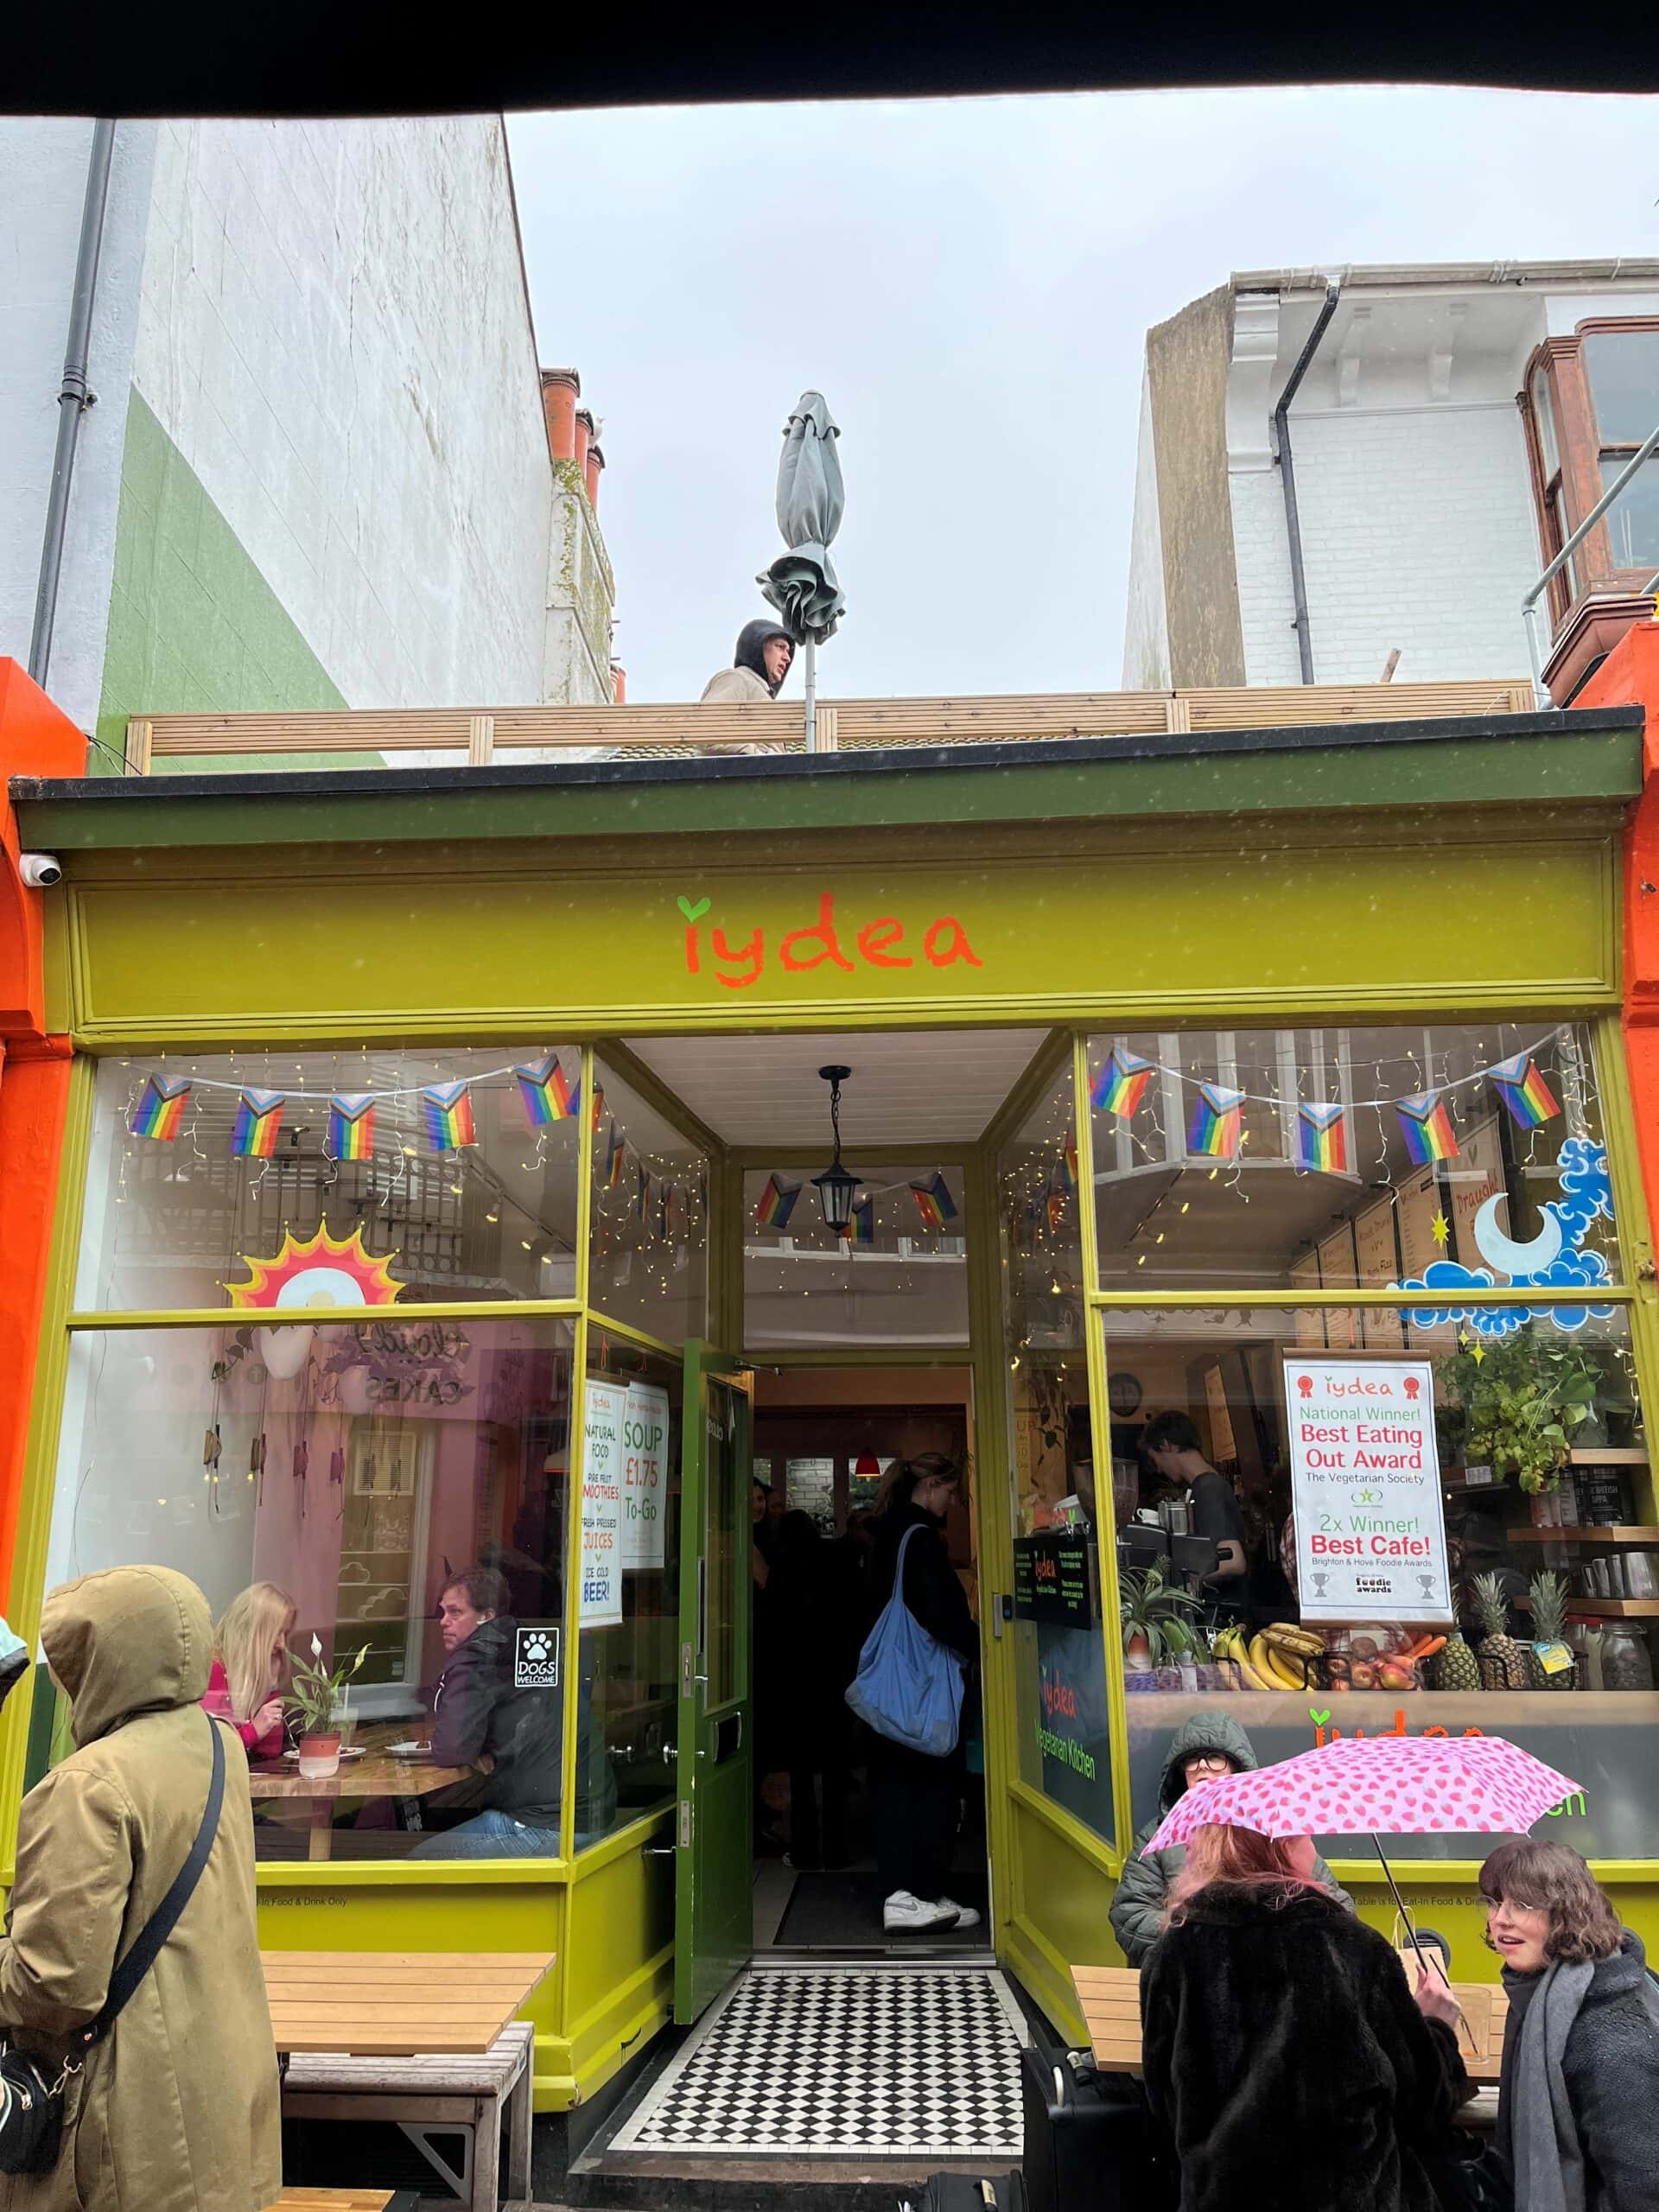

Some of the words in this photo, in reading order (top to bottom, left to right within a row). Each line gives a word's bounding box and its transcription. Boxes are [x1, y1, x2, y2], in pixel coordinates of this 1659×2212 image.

[677, 892, 983, 988] iydea
[1325, 1375, 1394, 1397] iydea
[1300, 1406, 1360, 1420] National
[1365, 1407, 1421, 1421] Winner!
[585, 1423, 616, 1441] NATURAL
[624, 1421, 663, 1452] SOUP
[1300, 1423, 1350, 1443] Best
[1357, 1424, 1422, 1448] Eating
[592, 1443, 609, 1459] FOOD
[1306, 1448, 1345, 1468] Out
[1353, 1450, 1422, 1469] Award
[626, 1456, 658, 1488] £1.75
[1306, 1472, 1325, 1483] The
[1328, 1472, 1383, 1484] Vegetarian
[1387, 1474, 1425, 1485] Society
[582, 1484, 620, 1500] MOOTHIES
[625, 1497, 657, 1521] To-Go
[1319, 1514, 1344, 1532] 2x
[1350, 1515, 1420, 1534] Winner!
[583, 1532, 613, 1550] JUICES
[1311, 1534, 1364, 1555] Best
[1370, 1535, 1431, 1556] Cafe!
[1312, 1557, 1344, 1567] Brighton
[1354, 1558, 1374, 1567] Hove
[1376, 1558, 1402, 1567] Foodie
[1403, 1560, 1433, 1568] Awards
[583, 1580, 610, 1603] BEER!
[518, 1661, 556, 1675] DOGS
[518, 1675, 556, 1684] WELCOME
[1042, 1664, 1077, 1719] iydea
[1067, 1736, 1096, 1782] Kitchen
[272, 1897, 293, 1907] Food
[296, 1897, 302, 1907] &
[303, 1897, 326, 1907] Drink
[328, 1897, 348, 1908] Only
[1402, 1897, 1427, 1906] Eat-In
[1431, 1897, 1453, 1906] Food
[1456, 1897, 1462, 1906] &
